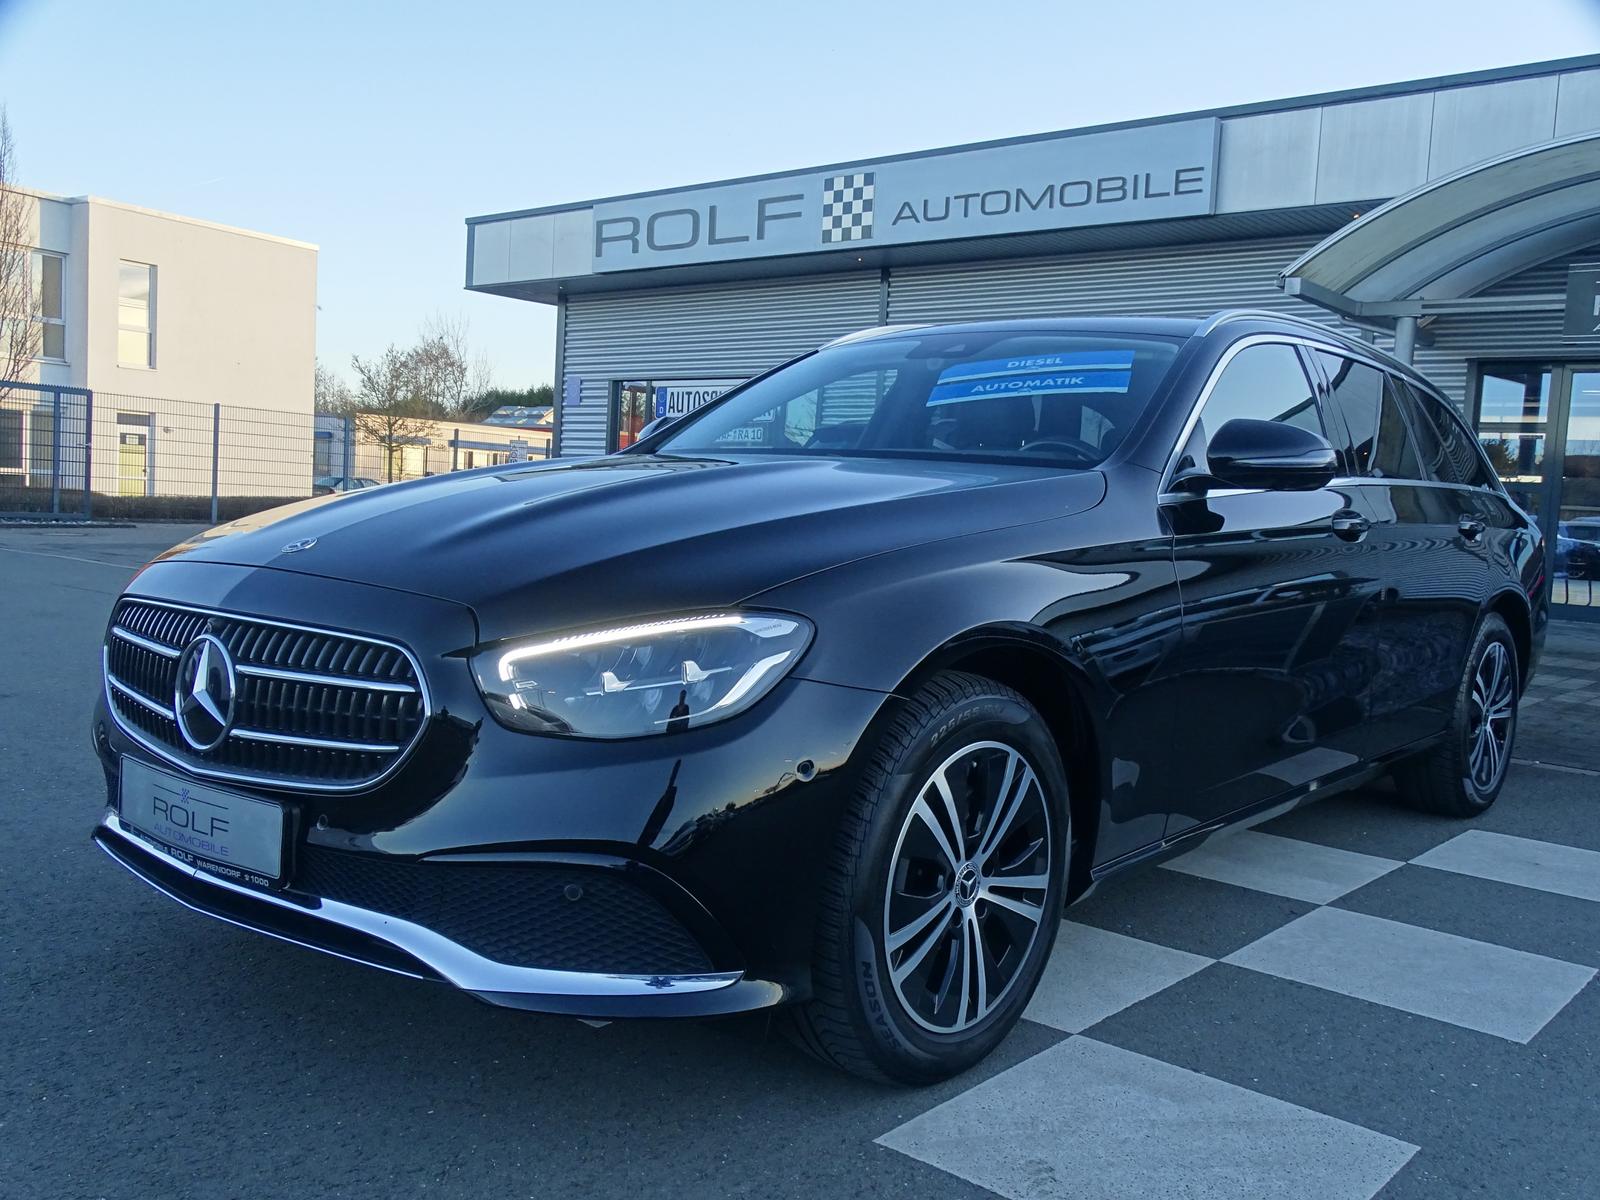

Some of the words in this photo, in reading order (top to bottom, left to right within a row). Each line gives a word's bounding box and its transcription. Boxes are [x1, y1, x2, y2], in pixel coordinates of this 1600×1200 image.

[595, 194, 804, 258] ROLF
[892, 166, 1205, 226] AUTOMOBILE
[1007, 357, 1063, 368] DIESEL
[971, 376, 1085, 393] AUTOMATIK
[153, 796, 230, 837] ROLF
[153, 823, 229, 857] AUTOMOBILE
[170, 847, 194, 862] ROLF
[197, 858, 241, 878] WARENDORF
[861, 960, 903, 1050] SEASON
